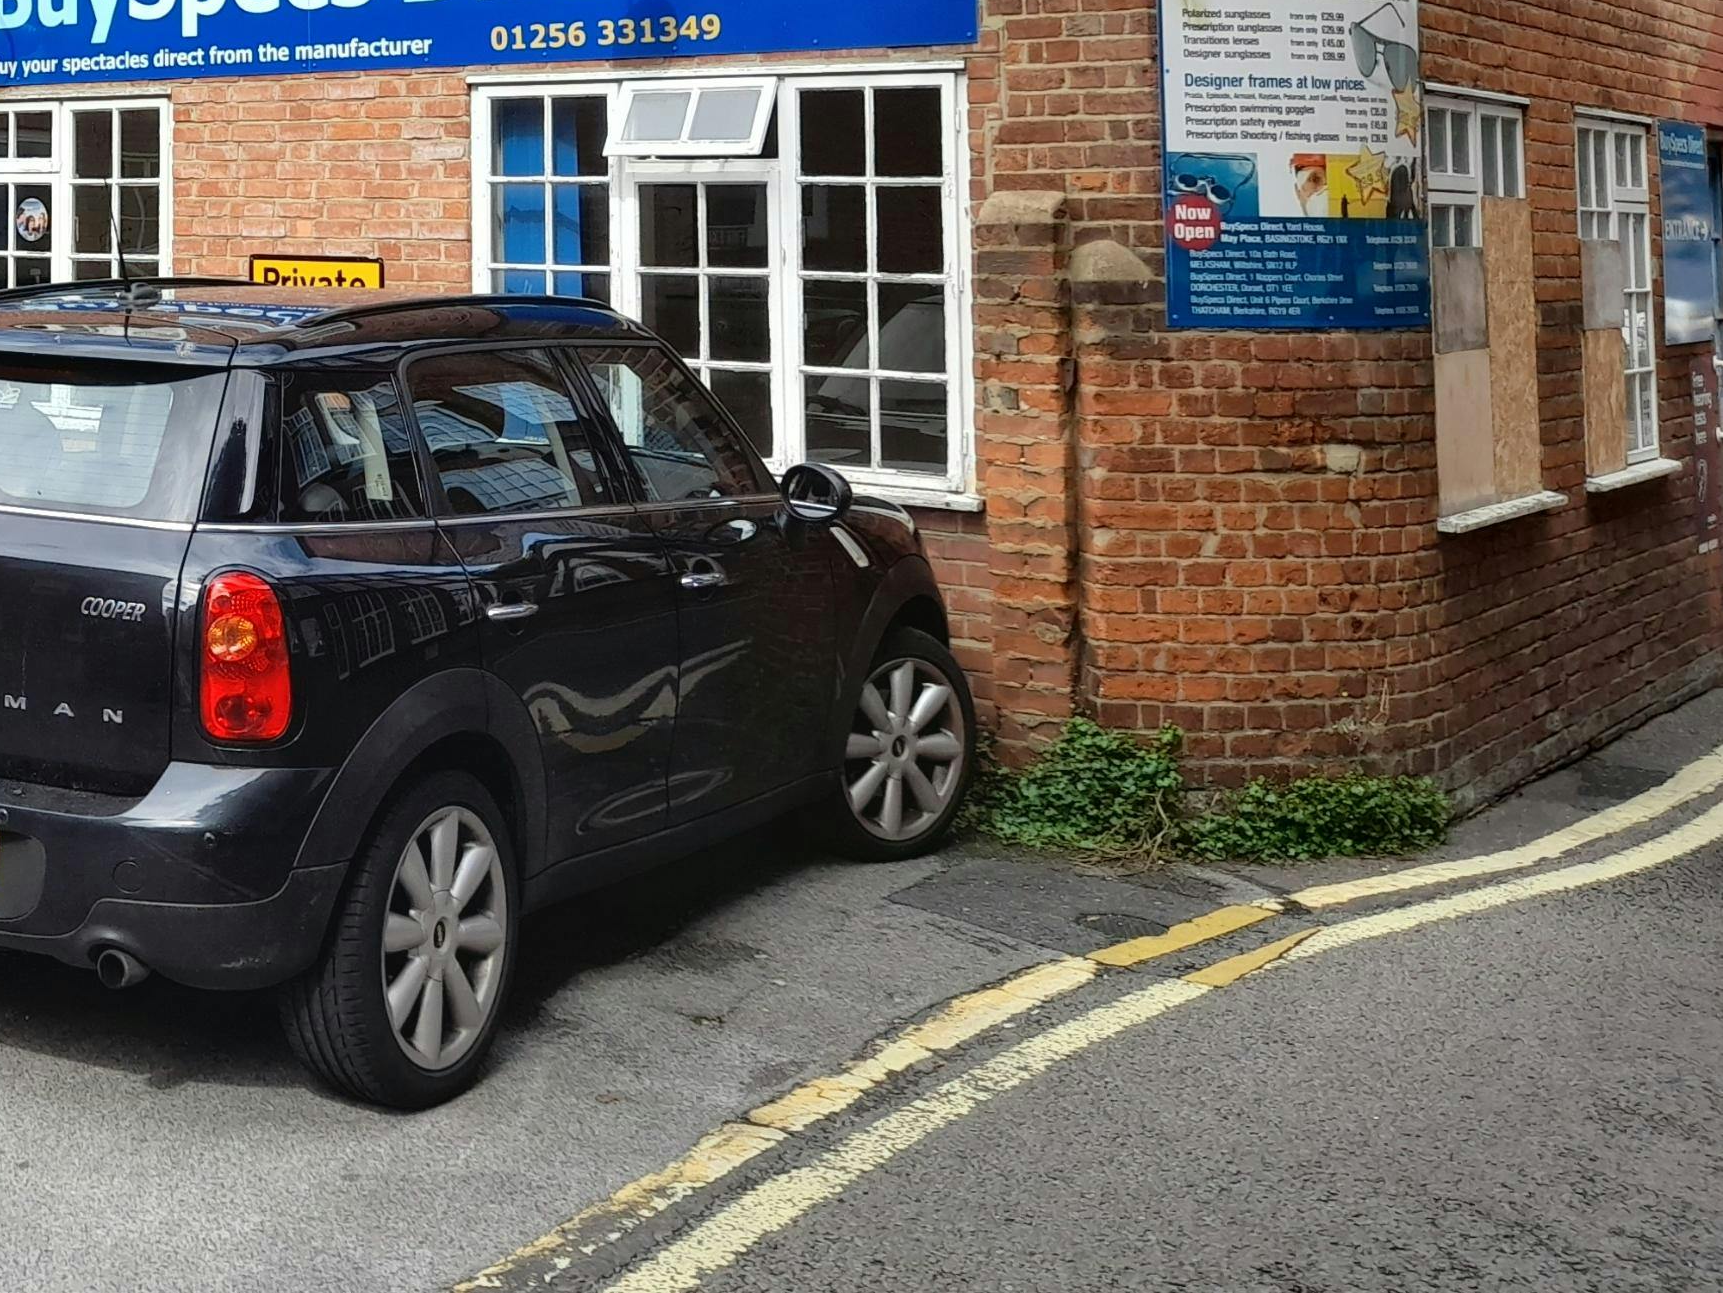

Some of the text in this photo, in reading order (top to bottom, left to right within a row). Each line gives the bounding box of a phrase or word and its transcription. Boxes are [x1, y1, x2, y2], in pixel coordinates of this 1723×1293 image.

[1182, 8, 1221, 18] Polarized
[1224, 10, 1271, 20] sunglasses
[490, 13, 721, 51] 01256 331349
[1182, 22, 1234, 33] Prescription
[1237, 23, 1283, 34] sunglasses
[1183, 35, 1230, 45] Transitions
[1232, 36, 1260, 46] lenses
[22, 58, 58, 77] your
[62, 50, 149, 75] spectacles
[153, 48, 205, 67] direct
[209, 45, 253, 65] from
[258, 43, 289, 62] the
[295, 37, 433, 61] manufacturer
[1183, 49, 1221, 60] Designer
[1224, 50, 1271, 60] sunglasses
[1184, 73, 1366, 93] Designer frames at low prices.
[1185, 103, 1237, 115] Prescription
[1285, 105, 1315, 116] goggles
[1185, 117, 1301, 129] Prescription safety eyewear
[1186, 130, 1238, 142] Prescription
[1285, 131, 1311, 143] fishing
[1313, 132, 1339, 143] glasses
[1174, 204, 1211, 220] Now
[1174, 223, 1215, 241] Open
[1220, 221, 1259, 232] BuySpecs
[80, 596, 146, 622] COOPER
